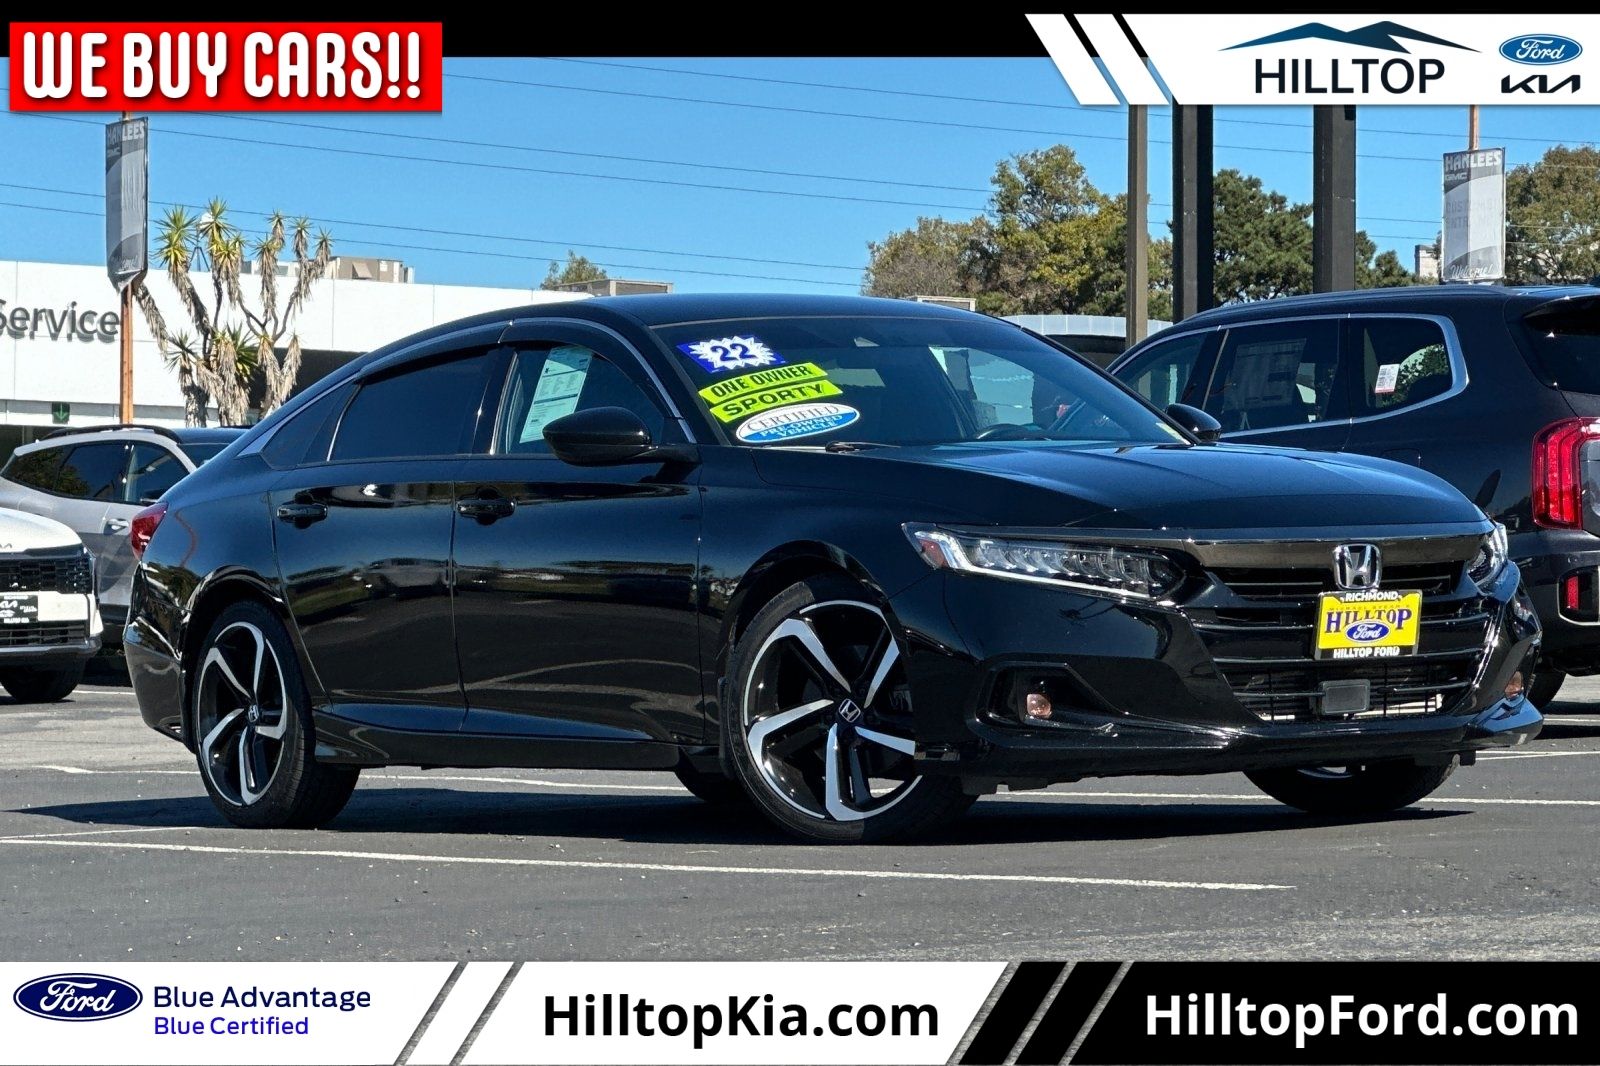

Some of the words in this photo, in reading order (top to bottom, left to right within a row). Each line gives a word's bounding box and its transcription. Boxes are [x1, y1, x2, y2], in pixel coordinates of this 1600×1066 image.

[710, 343, 758, 361] 22
[711, 378, 750, 398] ONE
[750, 365, 813, 386] OWNER
[722, 384, 824, 416] SPORTY
[747, 405, 839, 431] CERTIFIED
[777, 420, 838, 437] VEHICLE
[1346, 591, 1399, 602] RICHMOND
[1325, 608, 1412, 633] HILLTOP
[1352, 623, 1383, 640] Ford
[1333, 648, 1373, 659] HILLTOP
[1374, 646, 1400, 657] FORD
